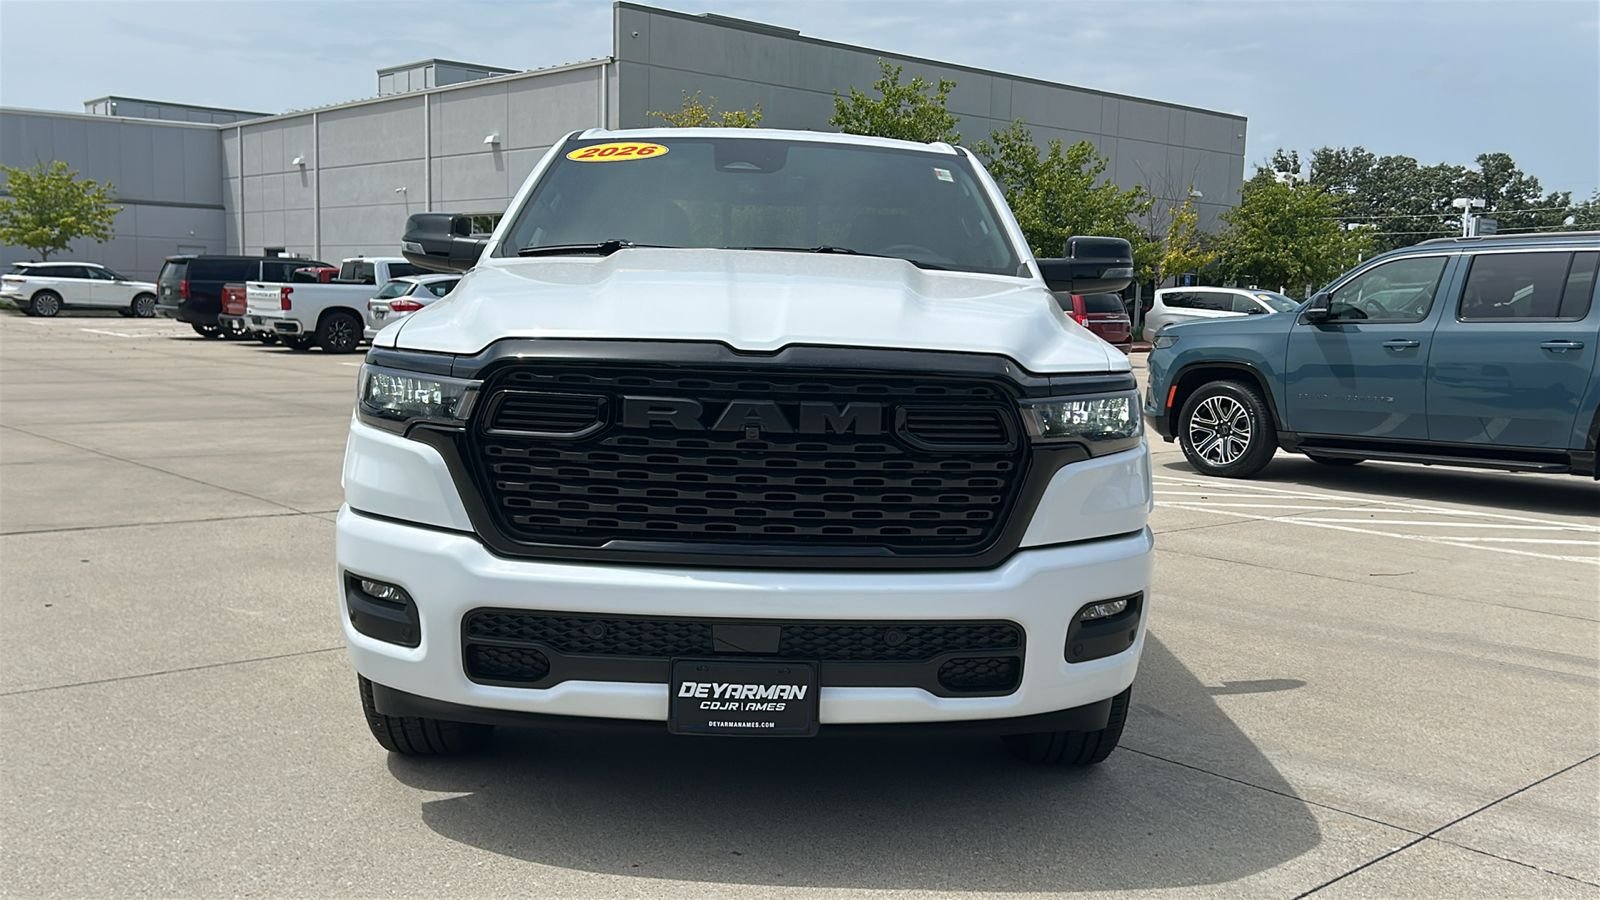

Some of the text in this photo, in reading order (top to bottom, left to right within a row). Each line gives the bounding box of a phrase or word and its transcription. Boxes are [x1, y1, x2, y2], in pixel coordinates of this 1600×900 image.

[576, 146, 658, 160] 2026
[622, 395, 882, 435] RAM
[678, 681, 808, 700] DEYARMAN
[744, 702, 786, 711] AMES
[708, 720, 775, 728] DEYARMANAMES.COM
